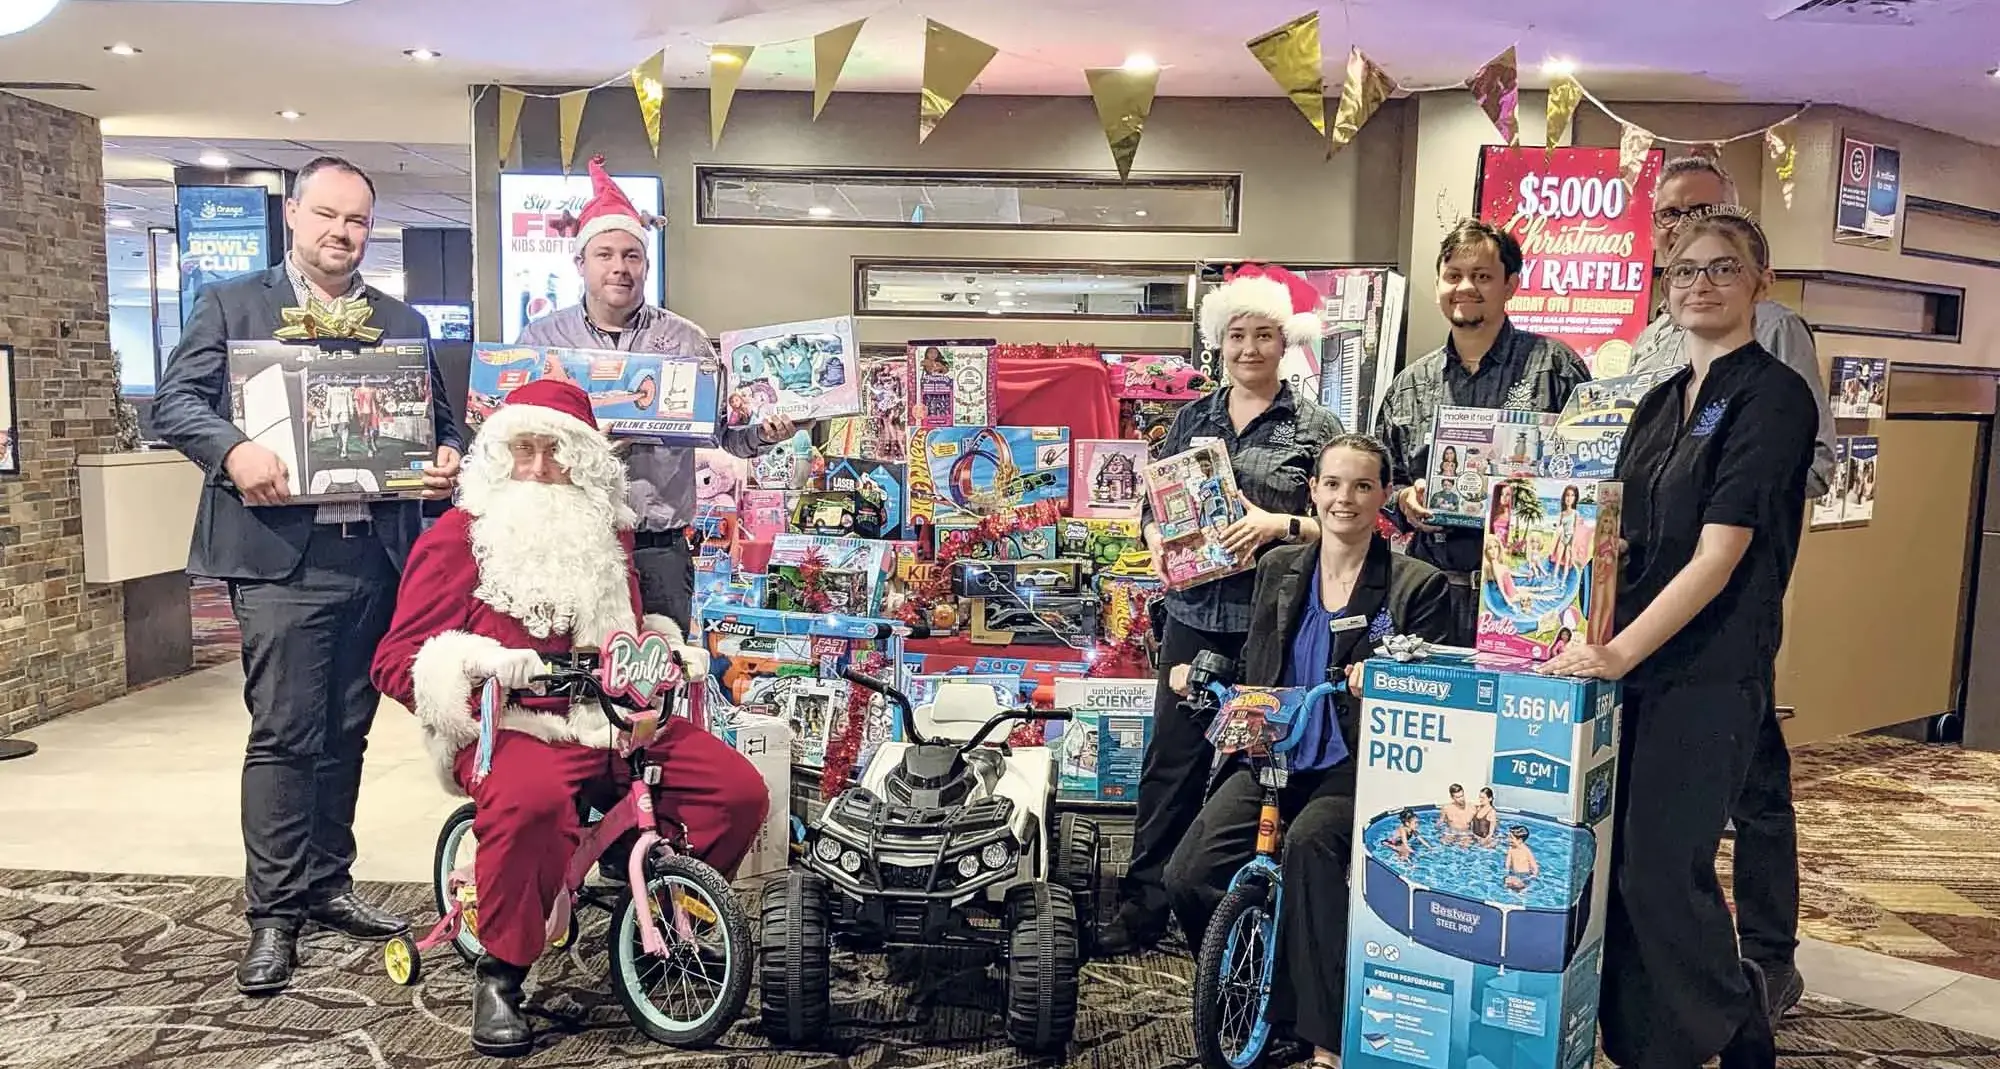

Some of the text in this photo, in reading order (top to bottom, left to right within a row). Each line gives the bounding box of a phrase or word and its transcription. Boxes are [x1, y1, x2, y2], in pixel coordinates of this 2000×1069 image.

[1517, 171, 1625, 219] $5,000
[1503, 212, 1635, 258] Christmas
[190, 240, 258, 255] BOWLS
[511, 239, 536, 252] KIDS
[538, 240, 565, 252] SOFT
[200, 256, 250, 271] CLUB
[1541, 259, 1645, 296] RAFFLE
[1572, 298, 1635, 314] DECEMBER
[316, 350, 355, 360] PS5
[1125, 370, 1153, 387] Barbie
[776, 404, 809, 414] FROZEN
[1444, 413, 1469, 421] make
[1470, 413, 1476, 421] it
[647, 422, 692, 431] SCOOTER
[833, 477, 855, 488] LASER
[1167, 547, 1196, 568] Barbie
[1477, 613, 1517, 635] Barbie
[817, 638, 848, 647] FAST
[608, 640, 676, 690] Barbie
[1092, 686, 1147, 696] unbelievable
[1373, 672, 1450, 699] Bestway
[1502, 694, 1570, 724] 3.66 M
[1370, 706, 1452, 743] STEEL
[1369, 740, 1424, 774] PRO
[1512, 759, 1551, 778] 76 CM
[1430, 901, 1481, 926] Bestway
[1436, 918, 1474, 934] STEEL PRO
[1374, 969, 1445, 991] PROVEN PERFORMANCE
